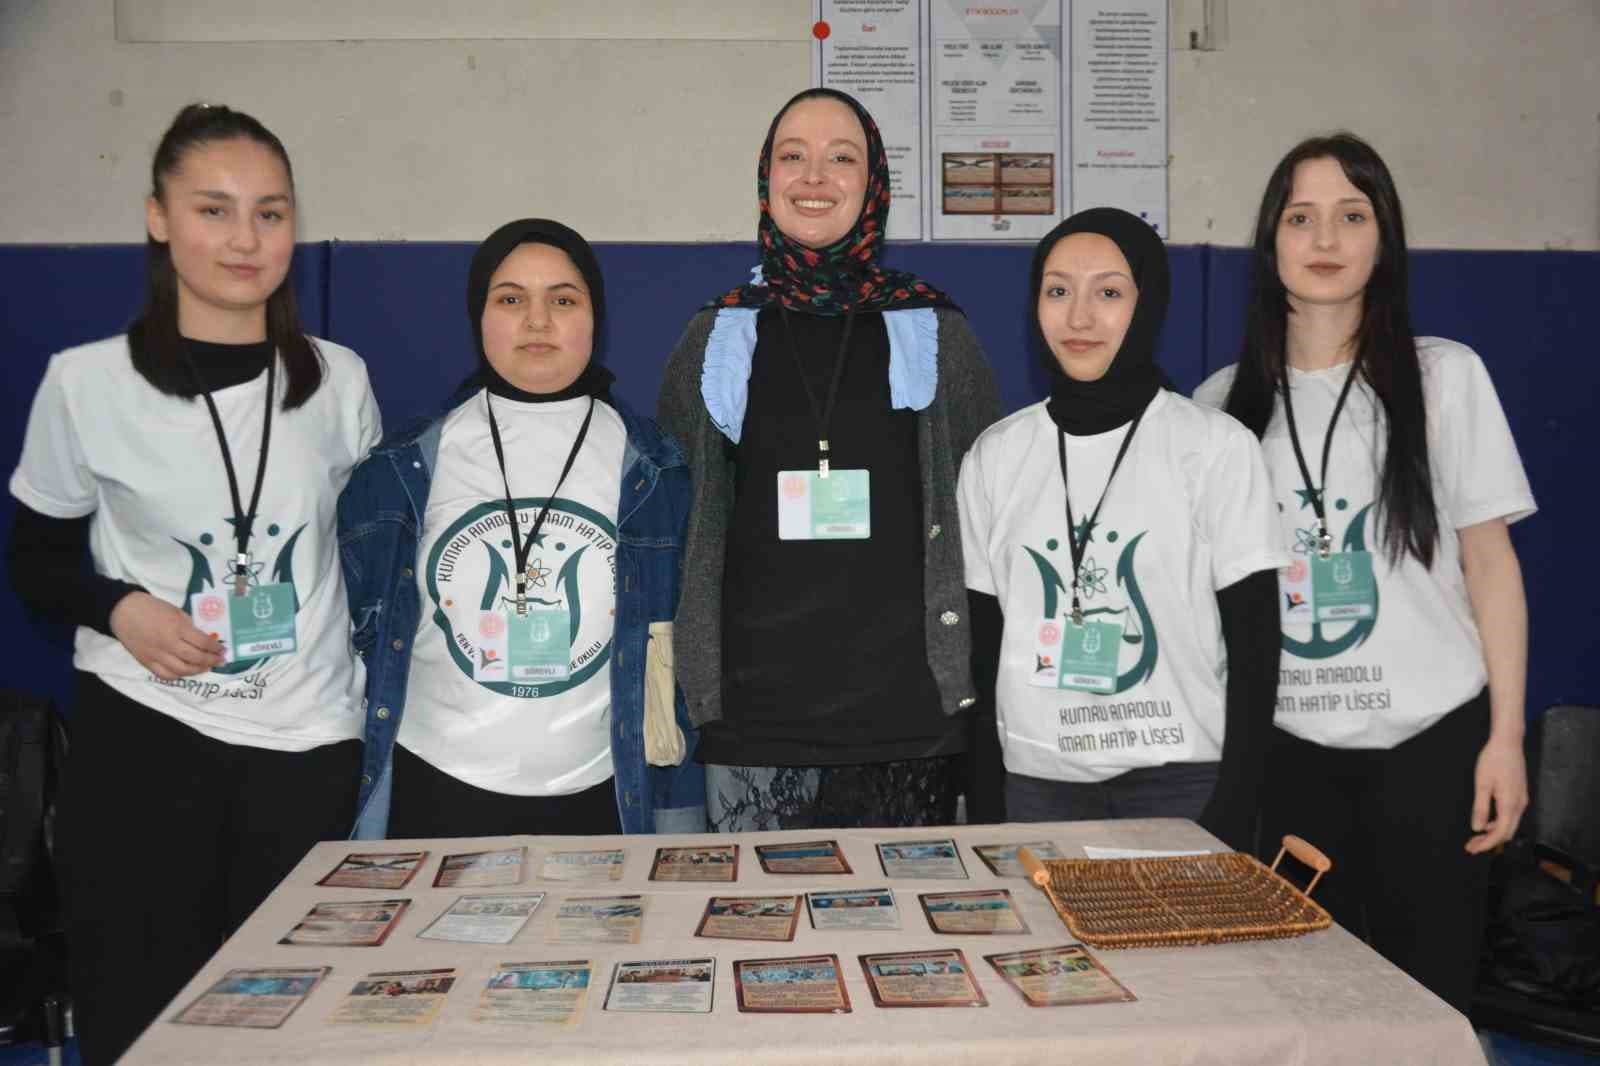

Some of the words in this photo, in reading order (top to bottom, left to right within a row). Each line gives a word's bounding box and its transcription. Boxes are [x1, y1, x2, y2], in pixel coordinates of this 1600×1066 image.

[438, 533, 471, 583] KUMRU
[468, 510, 529, 539] ANADOU
[575, 522, 613, 551] HATİP
[577, 641, 602, 665] OKULU
[1280, 667, 1313, 687] MRU
[1316, 664, 1383, 684] ANADOLU
[511, 686, 539, 699] 1976
[1300, 691, 1341, 713] HATİP
[1345, 688, 1391, 712] LİSESİ
[1059, 705, 1108, 726] KUMRU
[1108, 700, 1172, 721] ANADOLU
[1057, 731, 1097, 753] İMAM
[1099, 728, 1138, 751] HATİP
[1140, 722, 1185, 746] LİSESİ
